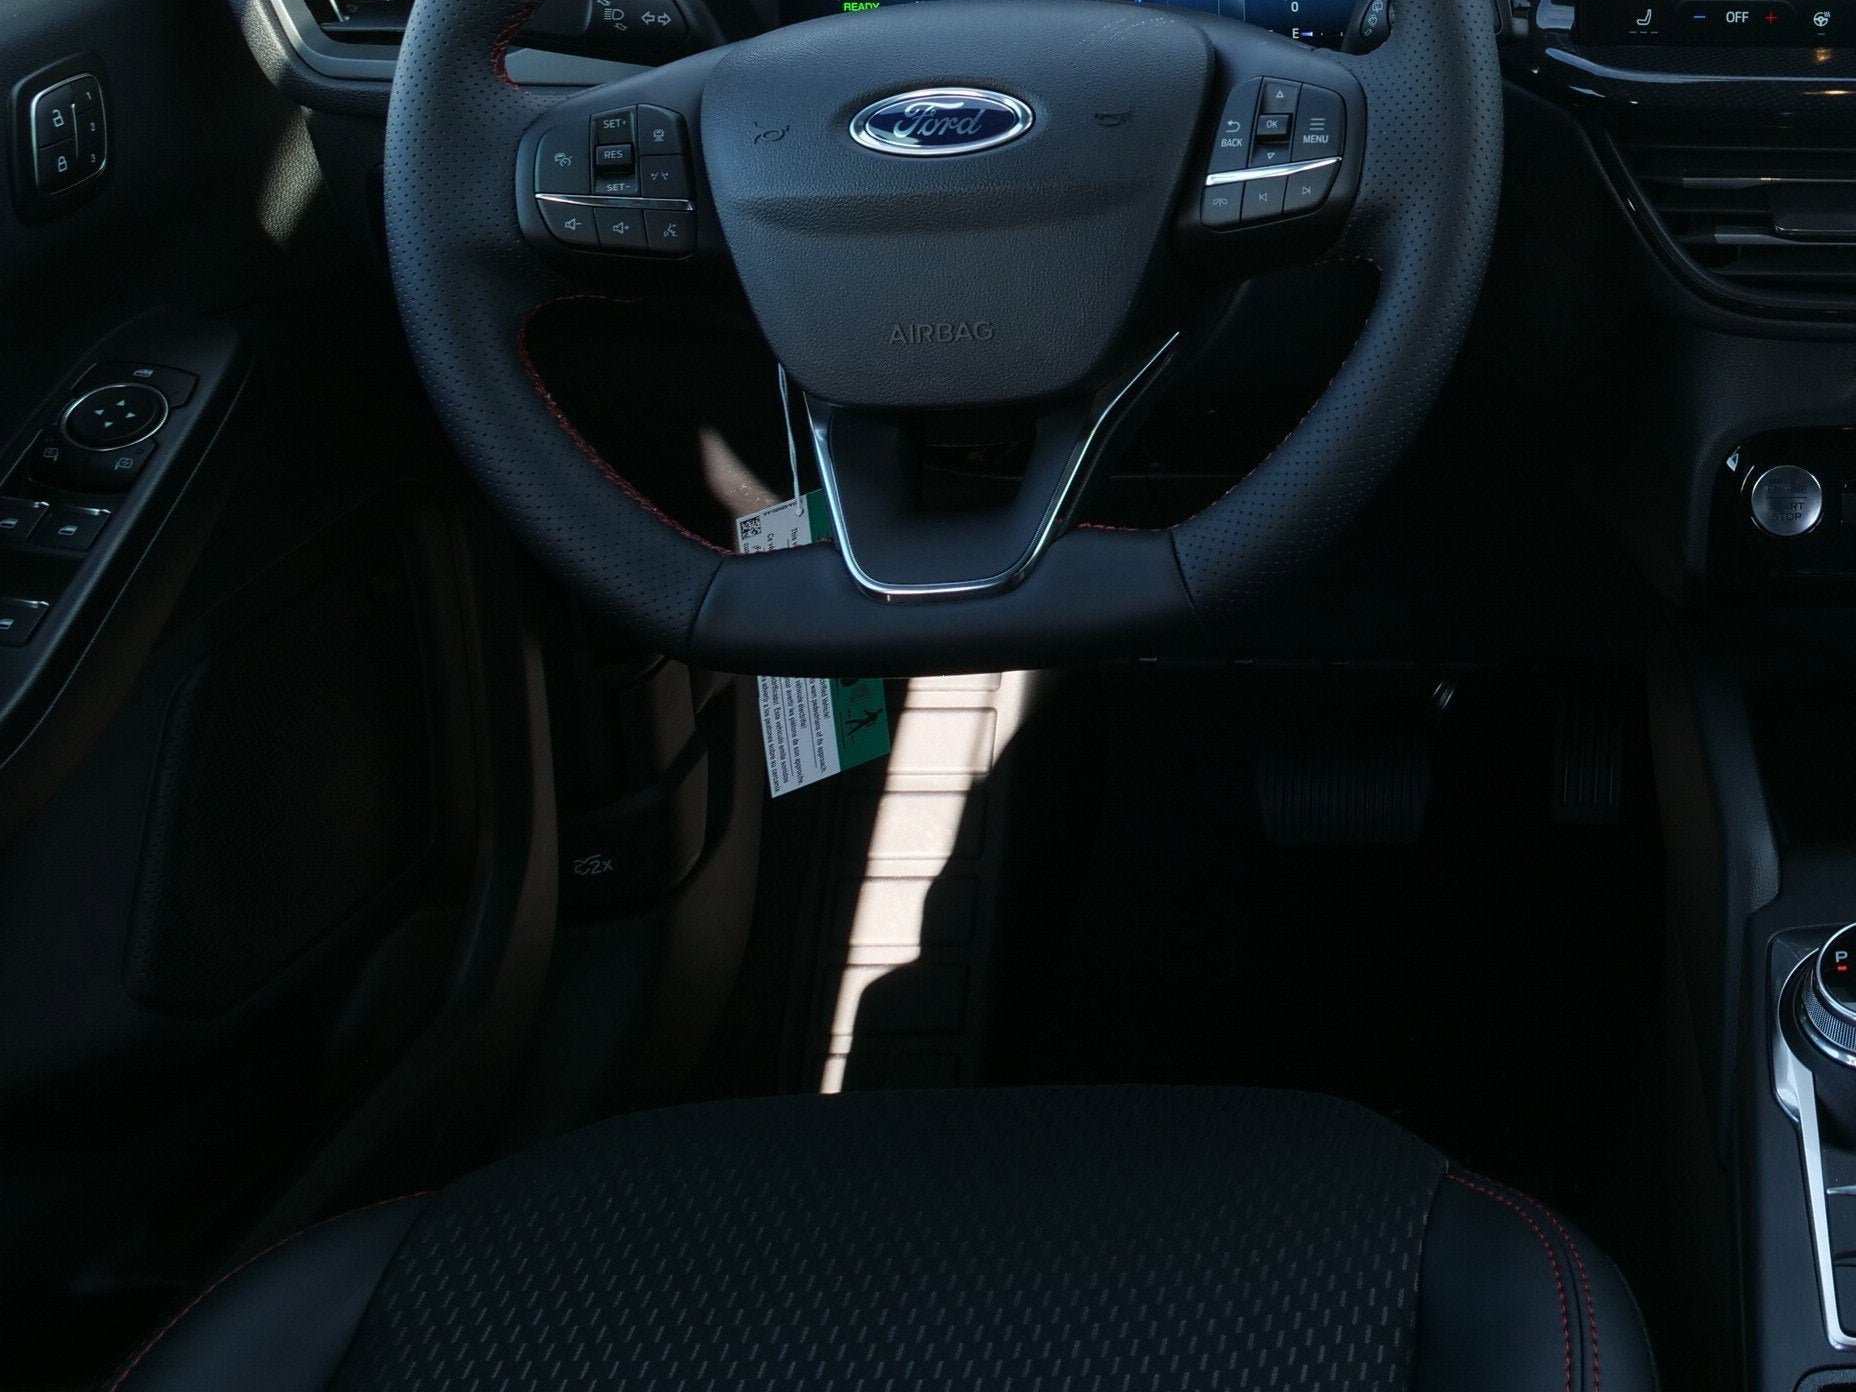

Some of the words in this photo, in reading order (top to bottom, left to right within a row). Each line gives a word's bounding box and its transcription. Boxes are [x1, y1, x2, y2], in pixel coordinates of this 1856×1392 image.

[1291, 1, 1299, 12] 0
[1725, 11, 1749, 24] OFF
[1292, 28, 1300, 39] E
[893, 101, 984, 139] Ford
[1266, 119, 1279, 128] OK
[1220, 138, 1243, 148] BACK
[1302, 134, 1329, 144] MENU
[604, 149, 623, 159] RES
[889, 320, 998, 346] AIRBAG
[1772, 512, 1802, 521] STOP
[1835, 950, 1848, 963] P
